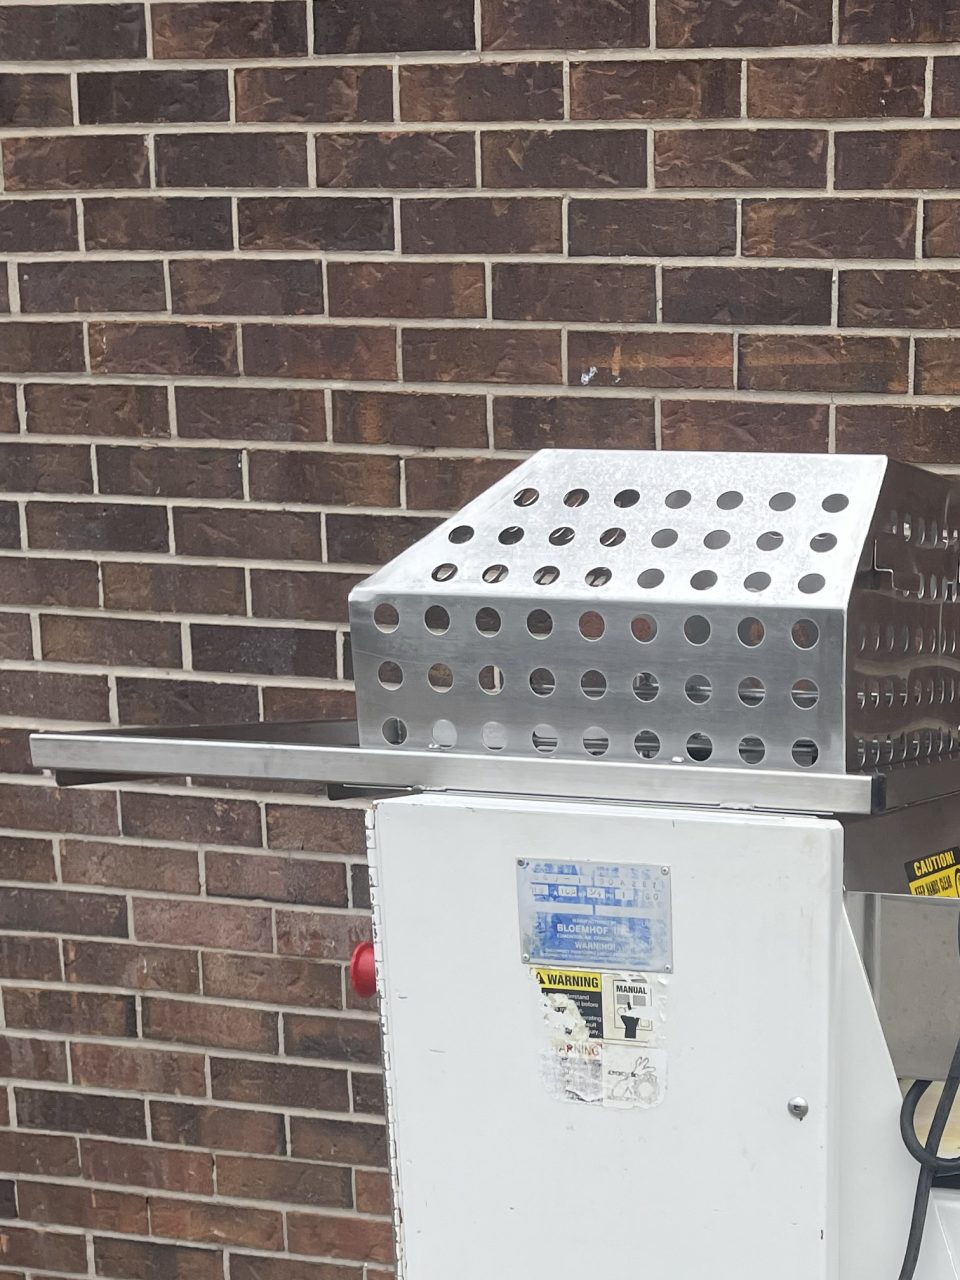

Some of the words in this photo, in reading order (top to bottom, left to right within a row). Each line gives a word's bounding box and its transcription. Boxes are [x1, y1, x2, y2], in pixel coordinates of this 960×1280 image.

[913, 850, 956, 877] CAUTION!
[926, 879, 941, 896] HANDS
[939, 874, 953, 891] CLEAR
[557, 923, 609, 935] BLOEMHOF
[547, 973, 599, 988] WARNING
[616, 985, 648, 995] MANUAL
